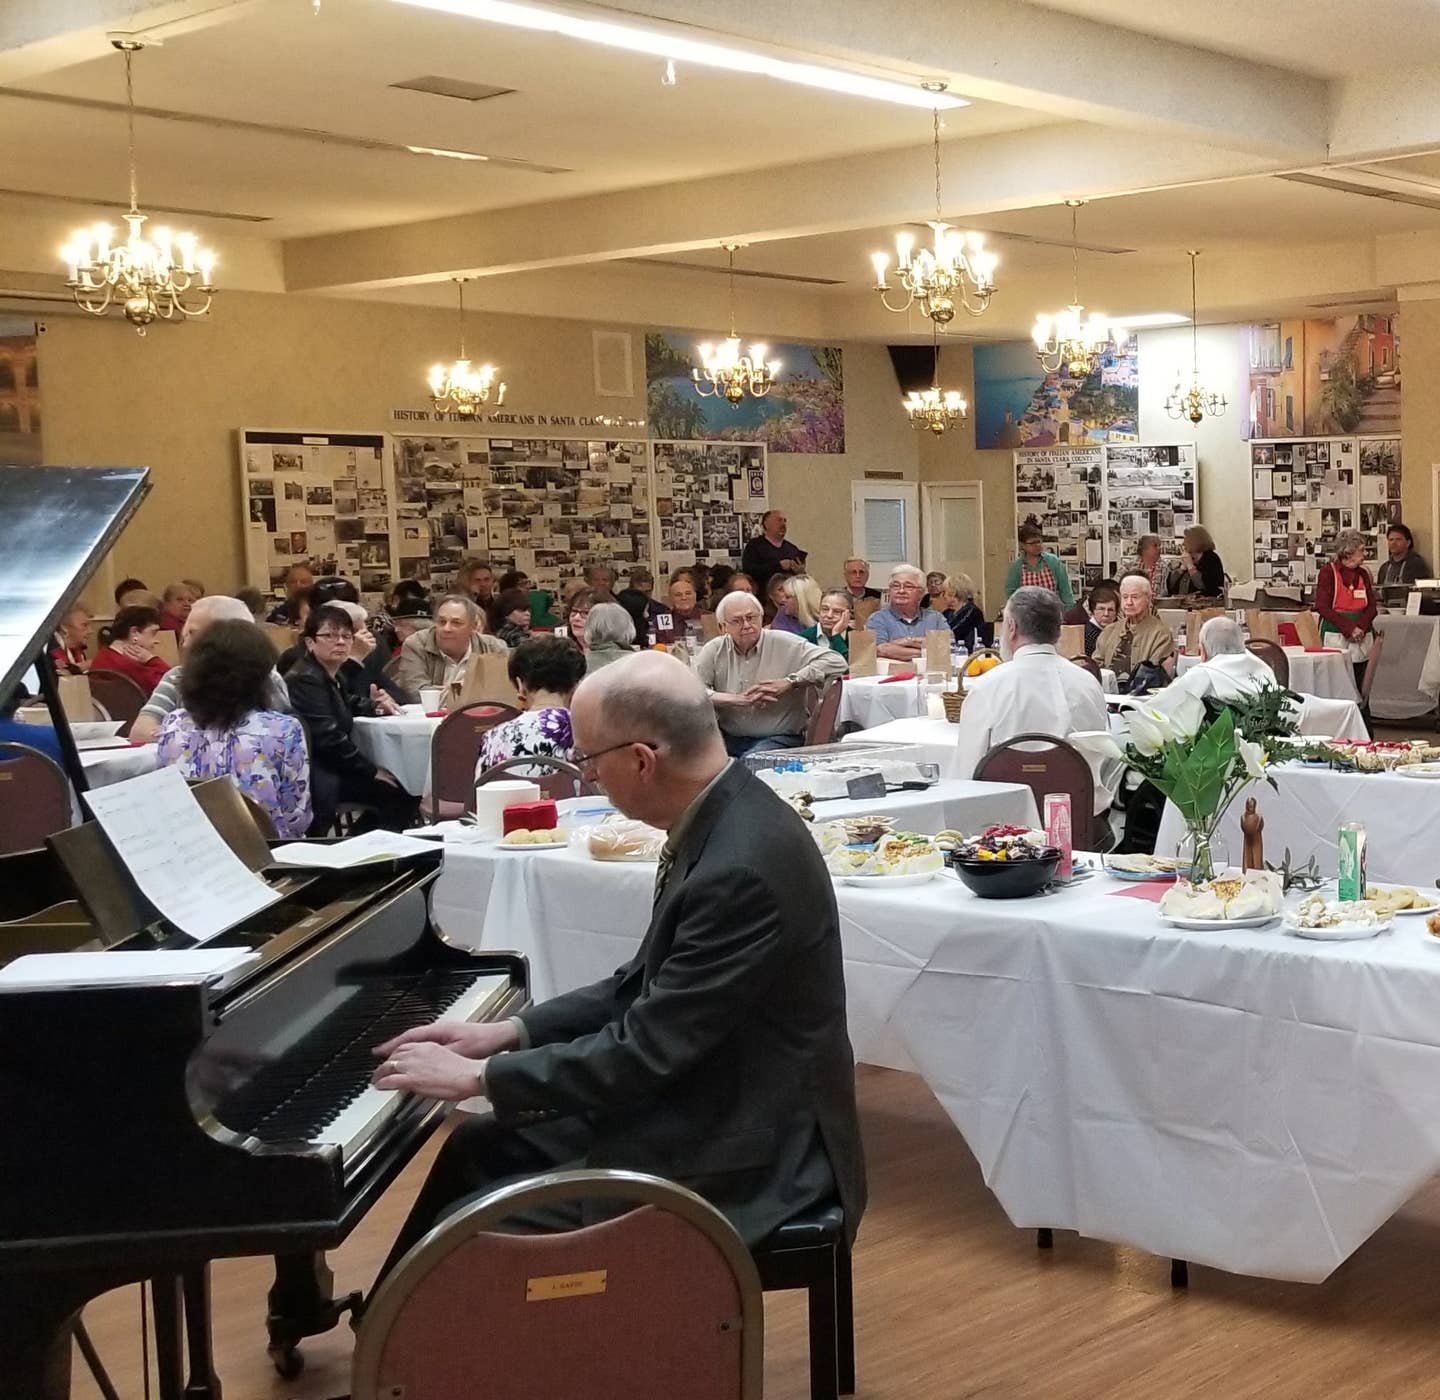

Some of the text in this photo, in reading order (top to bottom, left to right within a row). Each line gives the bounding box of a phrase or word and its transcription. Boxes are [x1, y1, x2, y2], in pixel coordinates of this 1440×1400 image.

[393, 410, 430, 422] HISTORY
[434, 411, 445, 422] OF
[448, 411, 483, 423] ITAN
[487, 411, 535, 425] AMERICANS
[538, 415, 547, 424] IN
[550, 415, 576, 425] SANTA
[660, 615, 670, 626] 12
